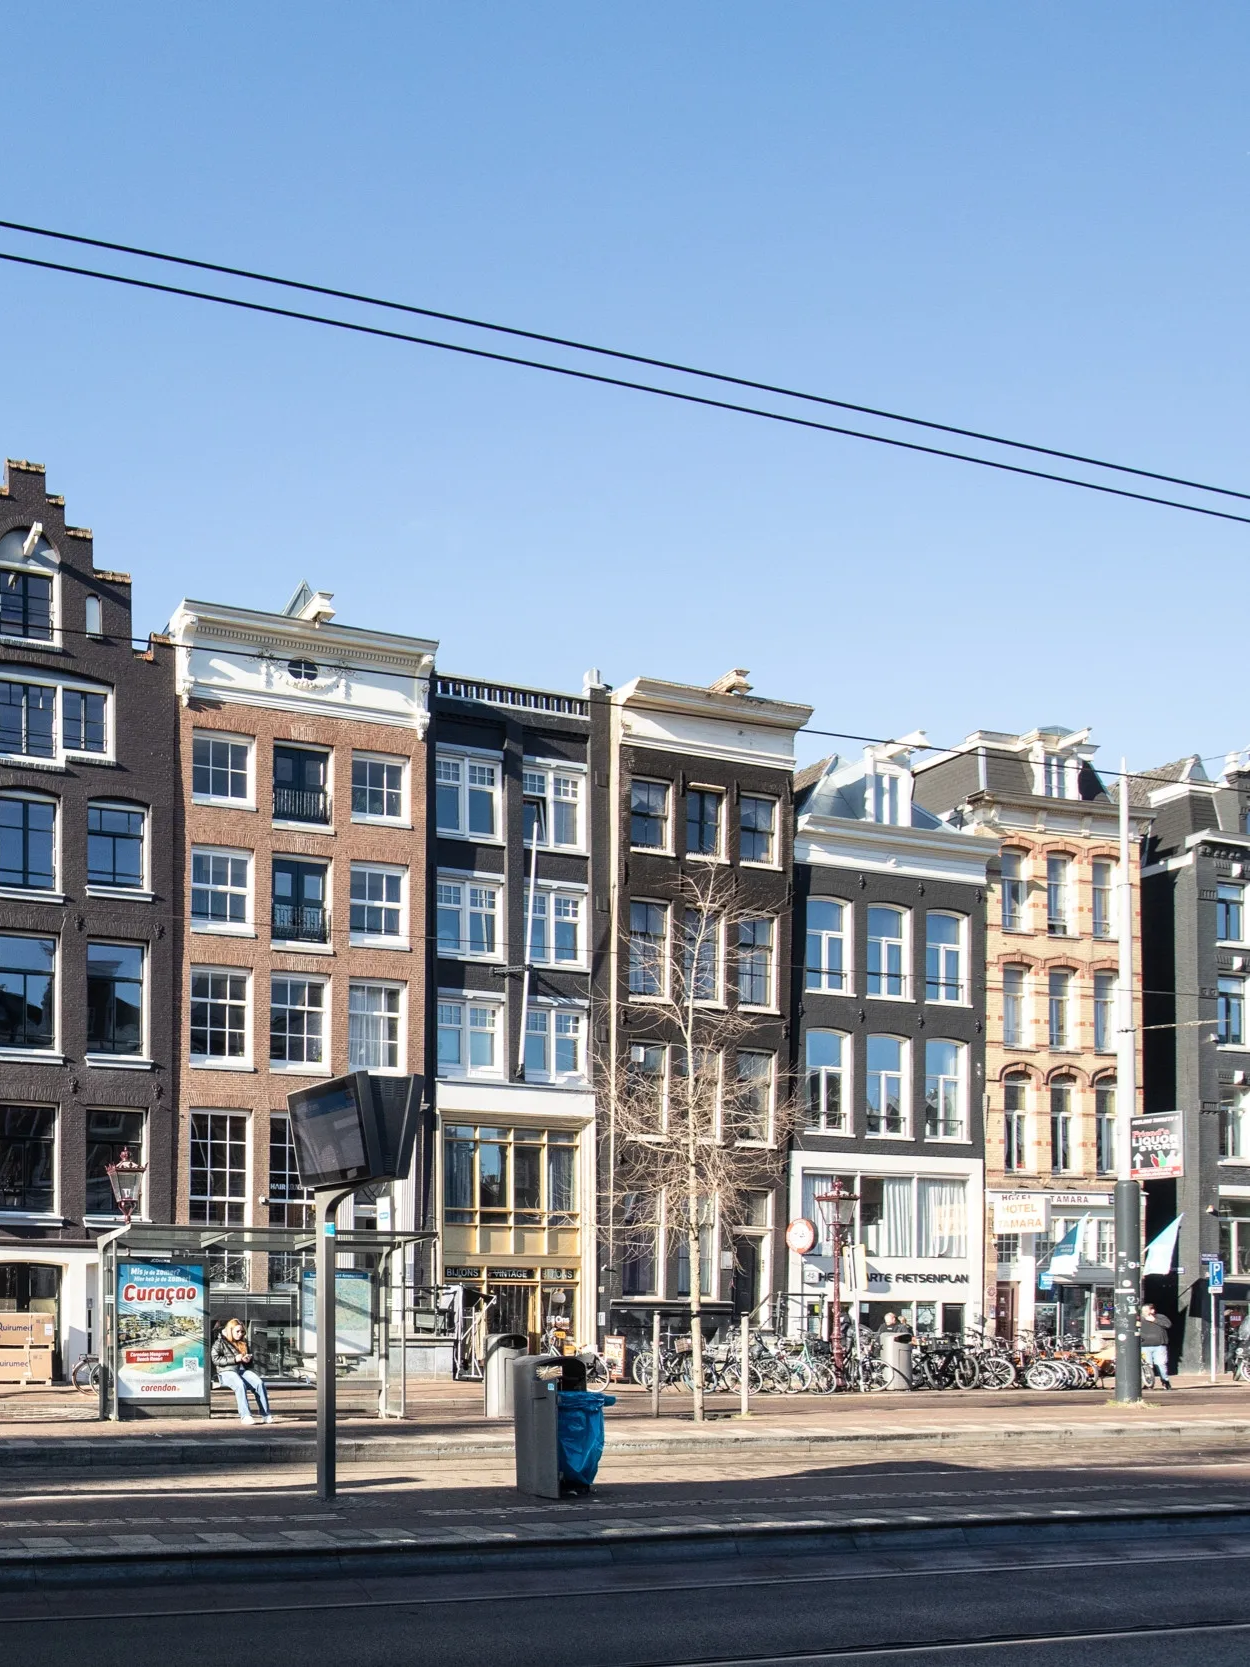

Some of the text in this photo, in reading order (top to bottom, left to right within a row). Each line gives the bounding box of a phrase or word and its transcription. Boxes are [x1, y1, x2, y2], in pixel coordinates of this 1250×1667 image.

[1132, 1134, 1179, 1147] LIQUOR
[1139, 1143, 1180, 1152] STORE
[1050, 1195, 1089, 1203] TAMARA
[1002, 1203, 1038, 1214] HOTEL
[998, 1218, 1043, 1229] TAMARA
[130, 1267, 143, 1275] Mis
[494, 1270, 528, 1278] VINTAGE
[1213, 1263, 1221, 1276] P
[895, 1273, 970, 1284] FIETSENPLAN
[123, 1283, 197, 1307] Curaçao
[140, 1384, 177, 1392] corendon
